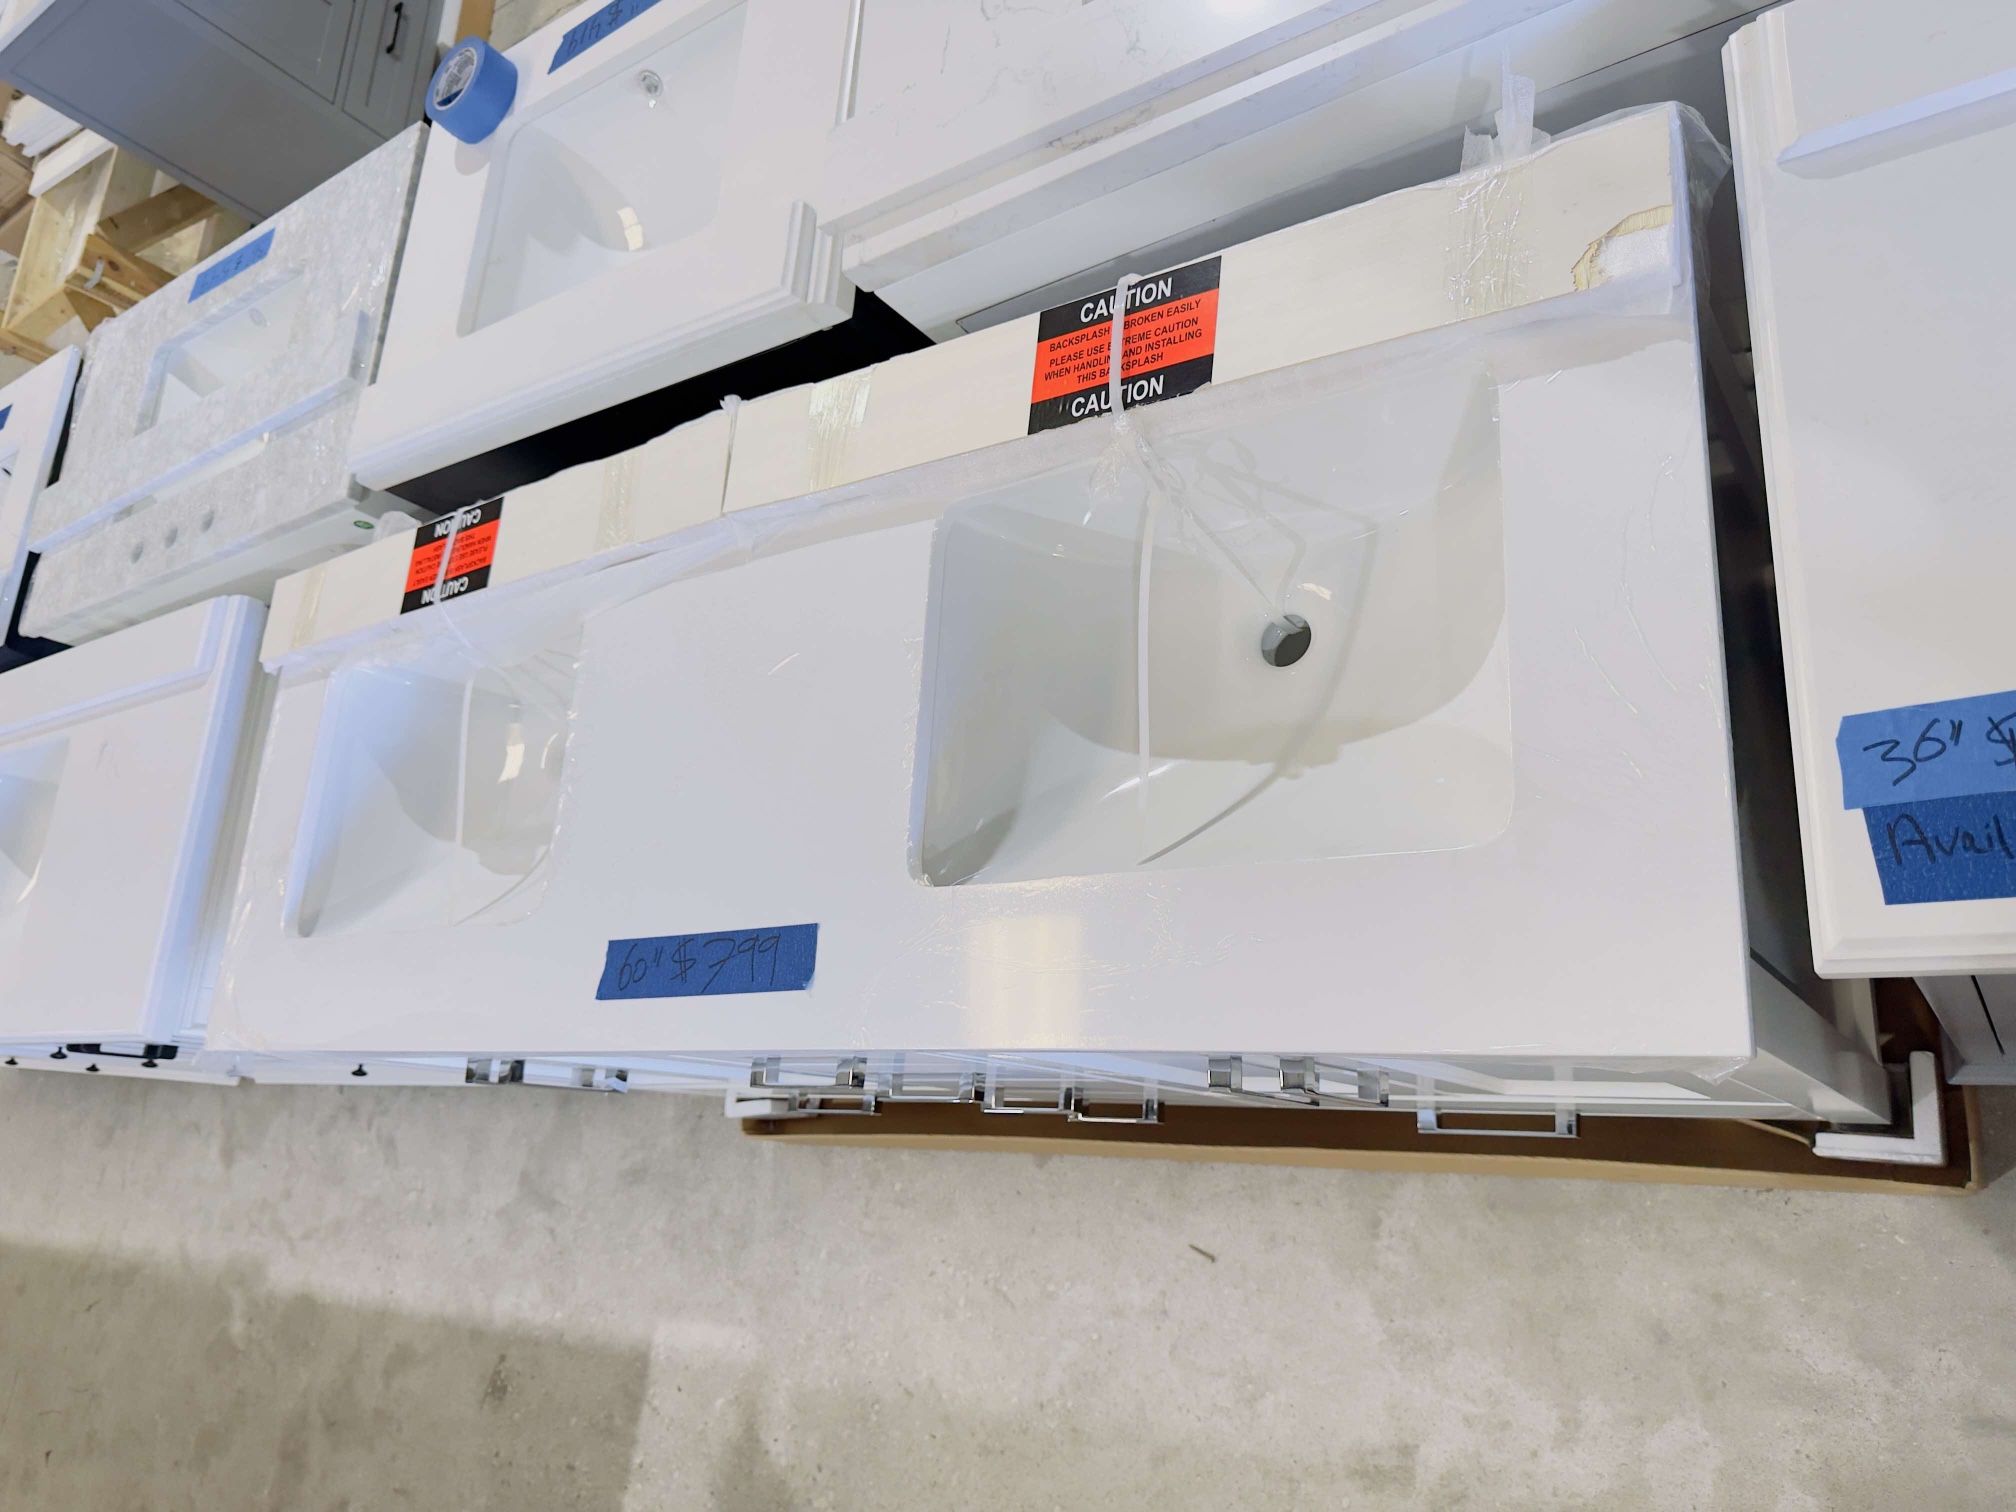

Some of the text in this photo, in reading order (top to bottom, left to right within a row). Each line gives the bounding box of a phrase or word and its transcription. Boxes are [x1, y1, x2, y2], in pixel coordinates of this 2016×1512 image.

[1049, 299, 1201, 353] BACKSPLASH BROKEN EASILY
[1049, 317, 1199, 367] PLEASE USE EREME CAUTION
[1044, 328, 1202, 381] WHEN HANDLIN AND INSTALLING
[1076, 352, 1164, 384] THIS BAKSPLASH
[433, 508, 482, 538] CAUON
[421, 576, 469, 604] CAUTON
[1862, 717, 1963, 787] 36"
[1886, 812, 2015, 866] Avail
[617, 933, 781, 994] 60" $799
